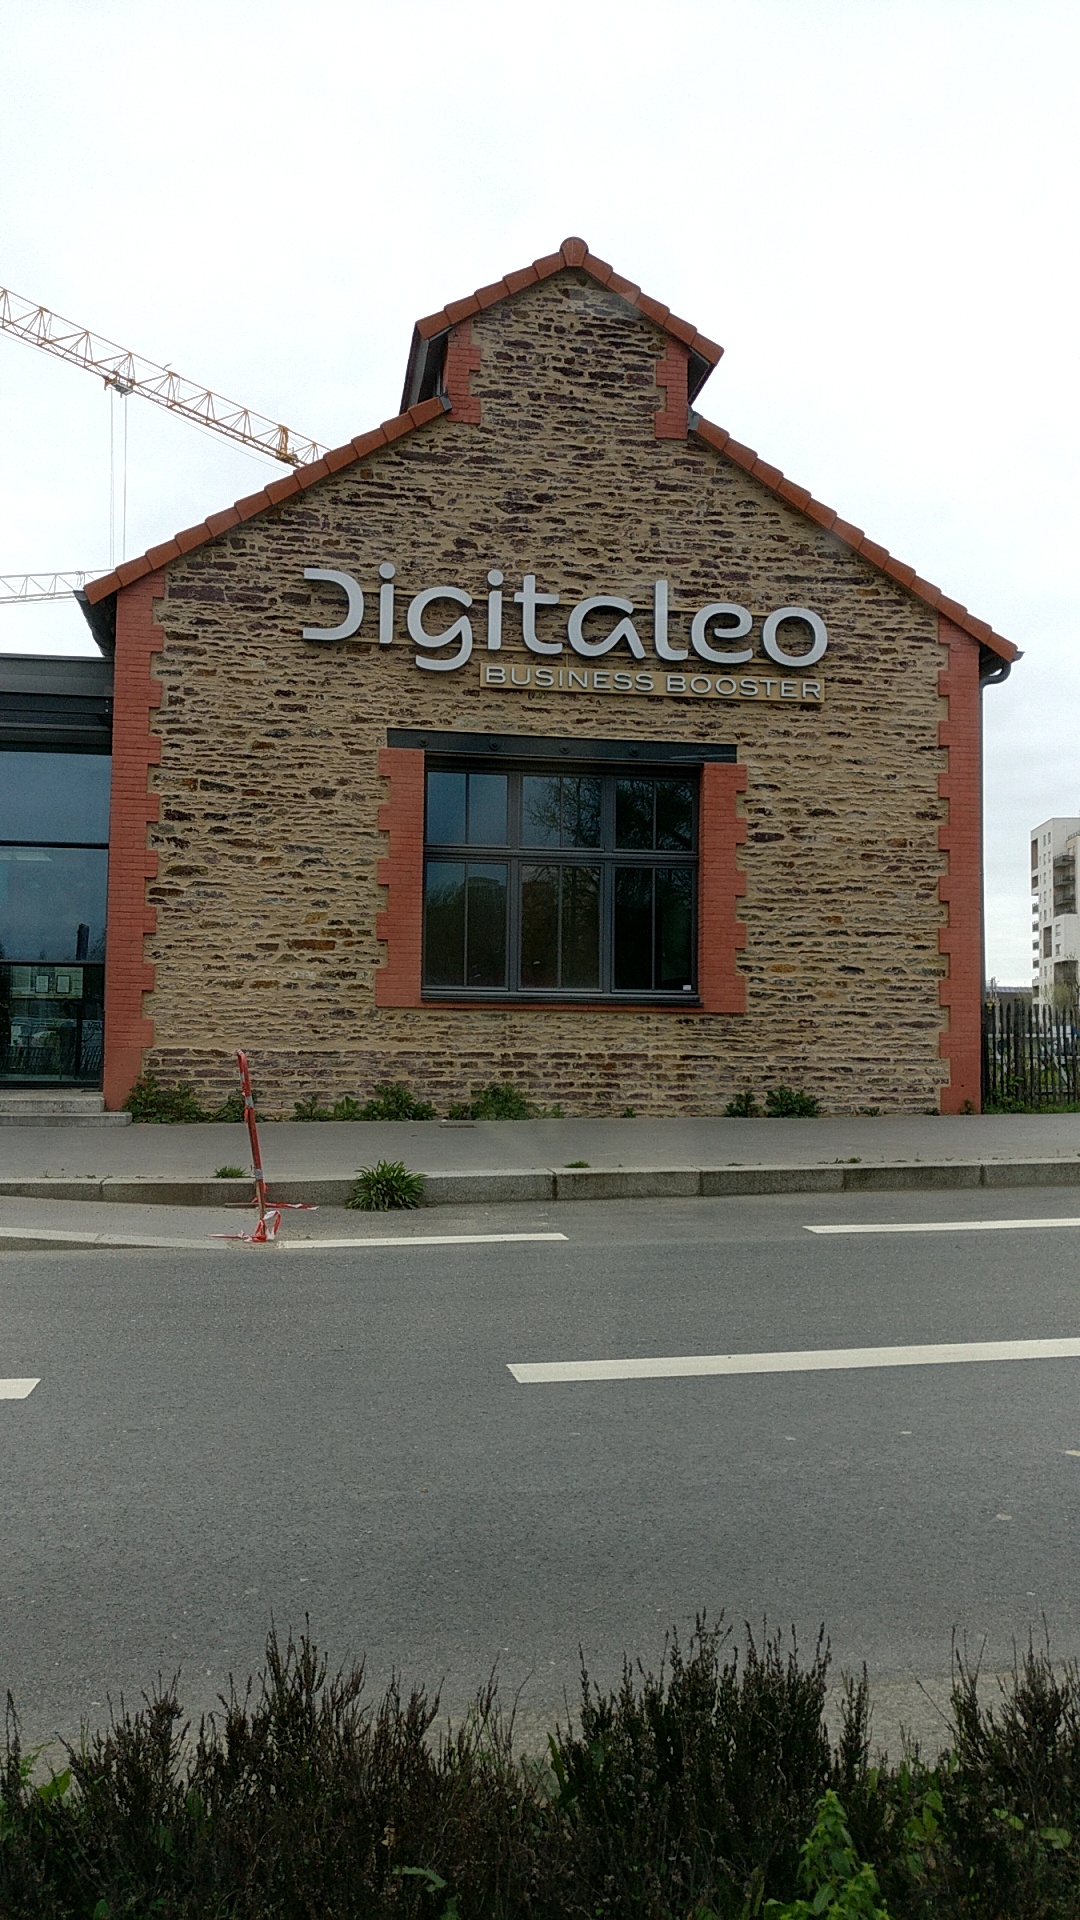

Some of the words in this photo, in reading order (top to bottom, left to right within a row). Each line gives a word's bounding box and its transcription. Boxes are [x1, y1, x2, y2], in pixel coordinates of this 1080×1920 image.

[302, 562, 829, 672] Digitaleo
[485, 665, 655, 693] BUSINESS
[665, 674, 822, 699] BOOSTER
